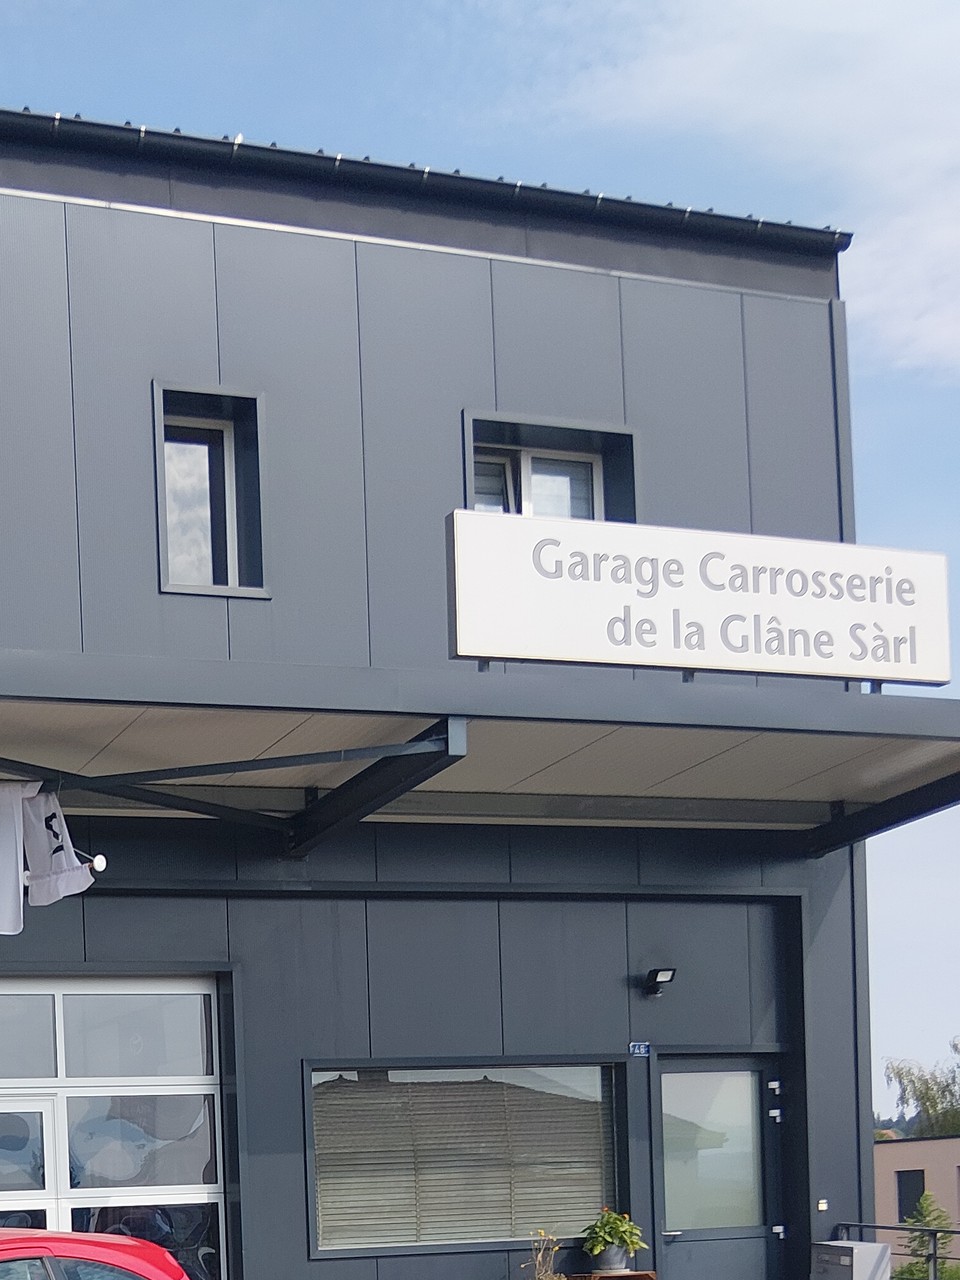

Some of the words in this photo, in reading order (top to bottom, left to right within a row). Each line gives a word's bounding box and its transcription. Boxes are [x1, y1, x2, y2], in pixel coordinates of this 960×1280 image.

[531, 538, 685, 599] Garage
[698, 551, 916, 607] Carrosserie
[606, 606, 658, 648] de
[672, 608, 706, 652] la
[719, 614, 835, 660] Glâne
[847, 621, 917, 665] Sàrl
